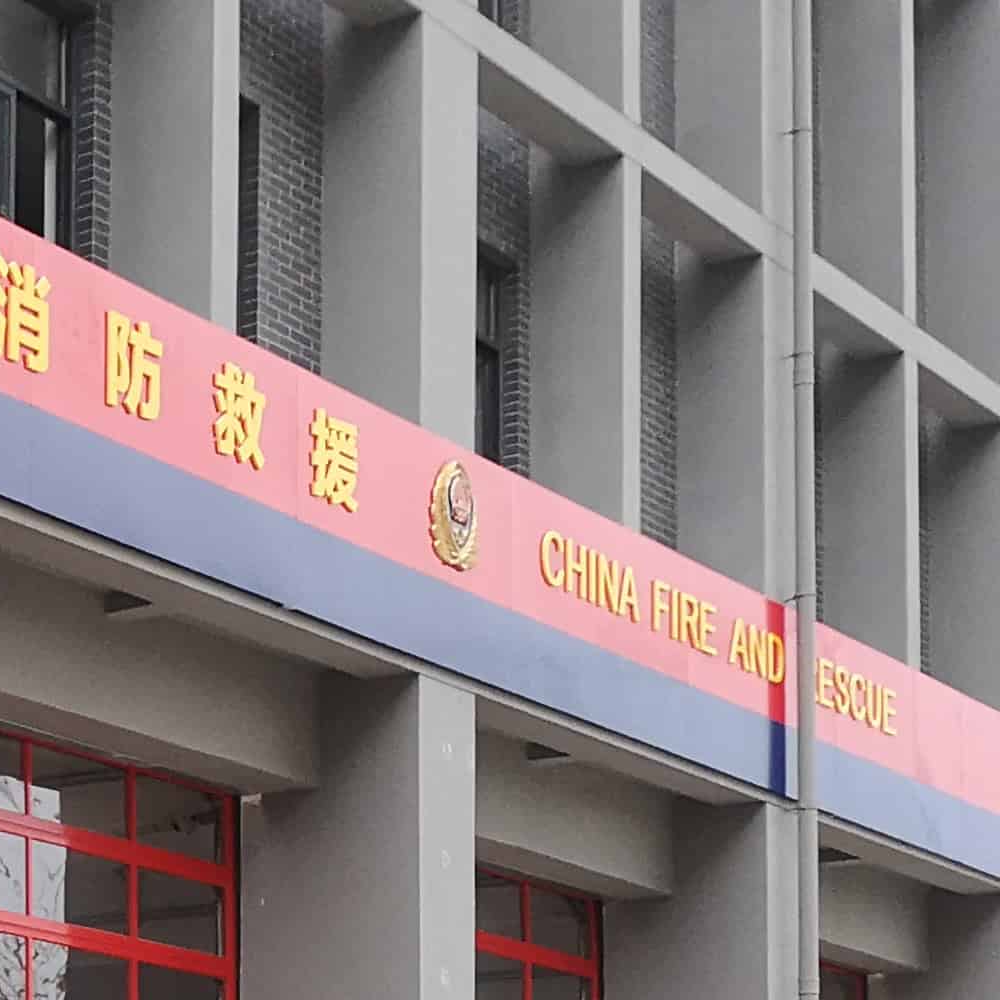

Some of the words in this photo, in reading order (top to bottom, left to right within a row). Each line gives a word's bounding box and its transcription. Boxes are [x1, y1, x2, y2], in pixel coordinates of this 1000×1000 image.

[540, 530, 640, 624] CHINA
[651, 578, 718, 657] FIRE
[729, 617, 785, 684] AND
[815, 657, 897, 736] ESCUE
